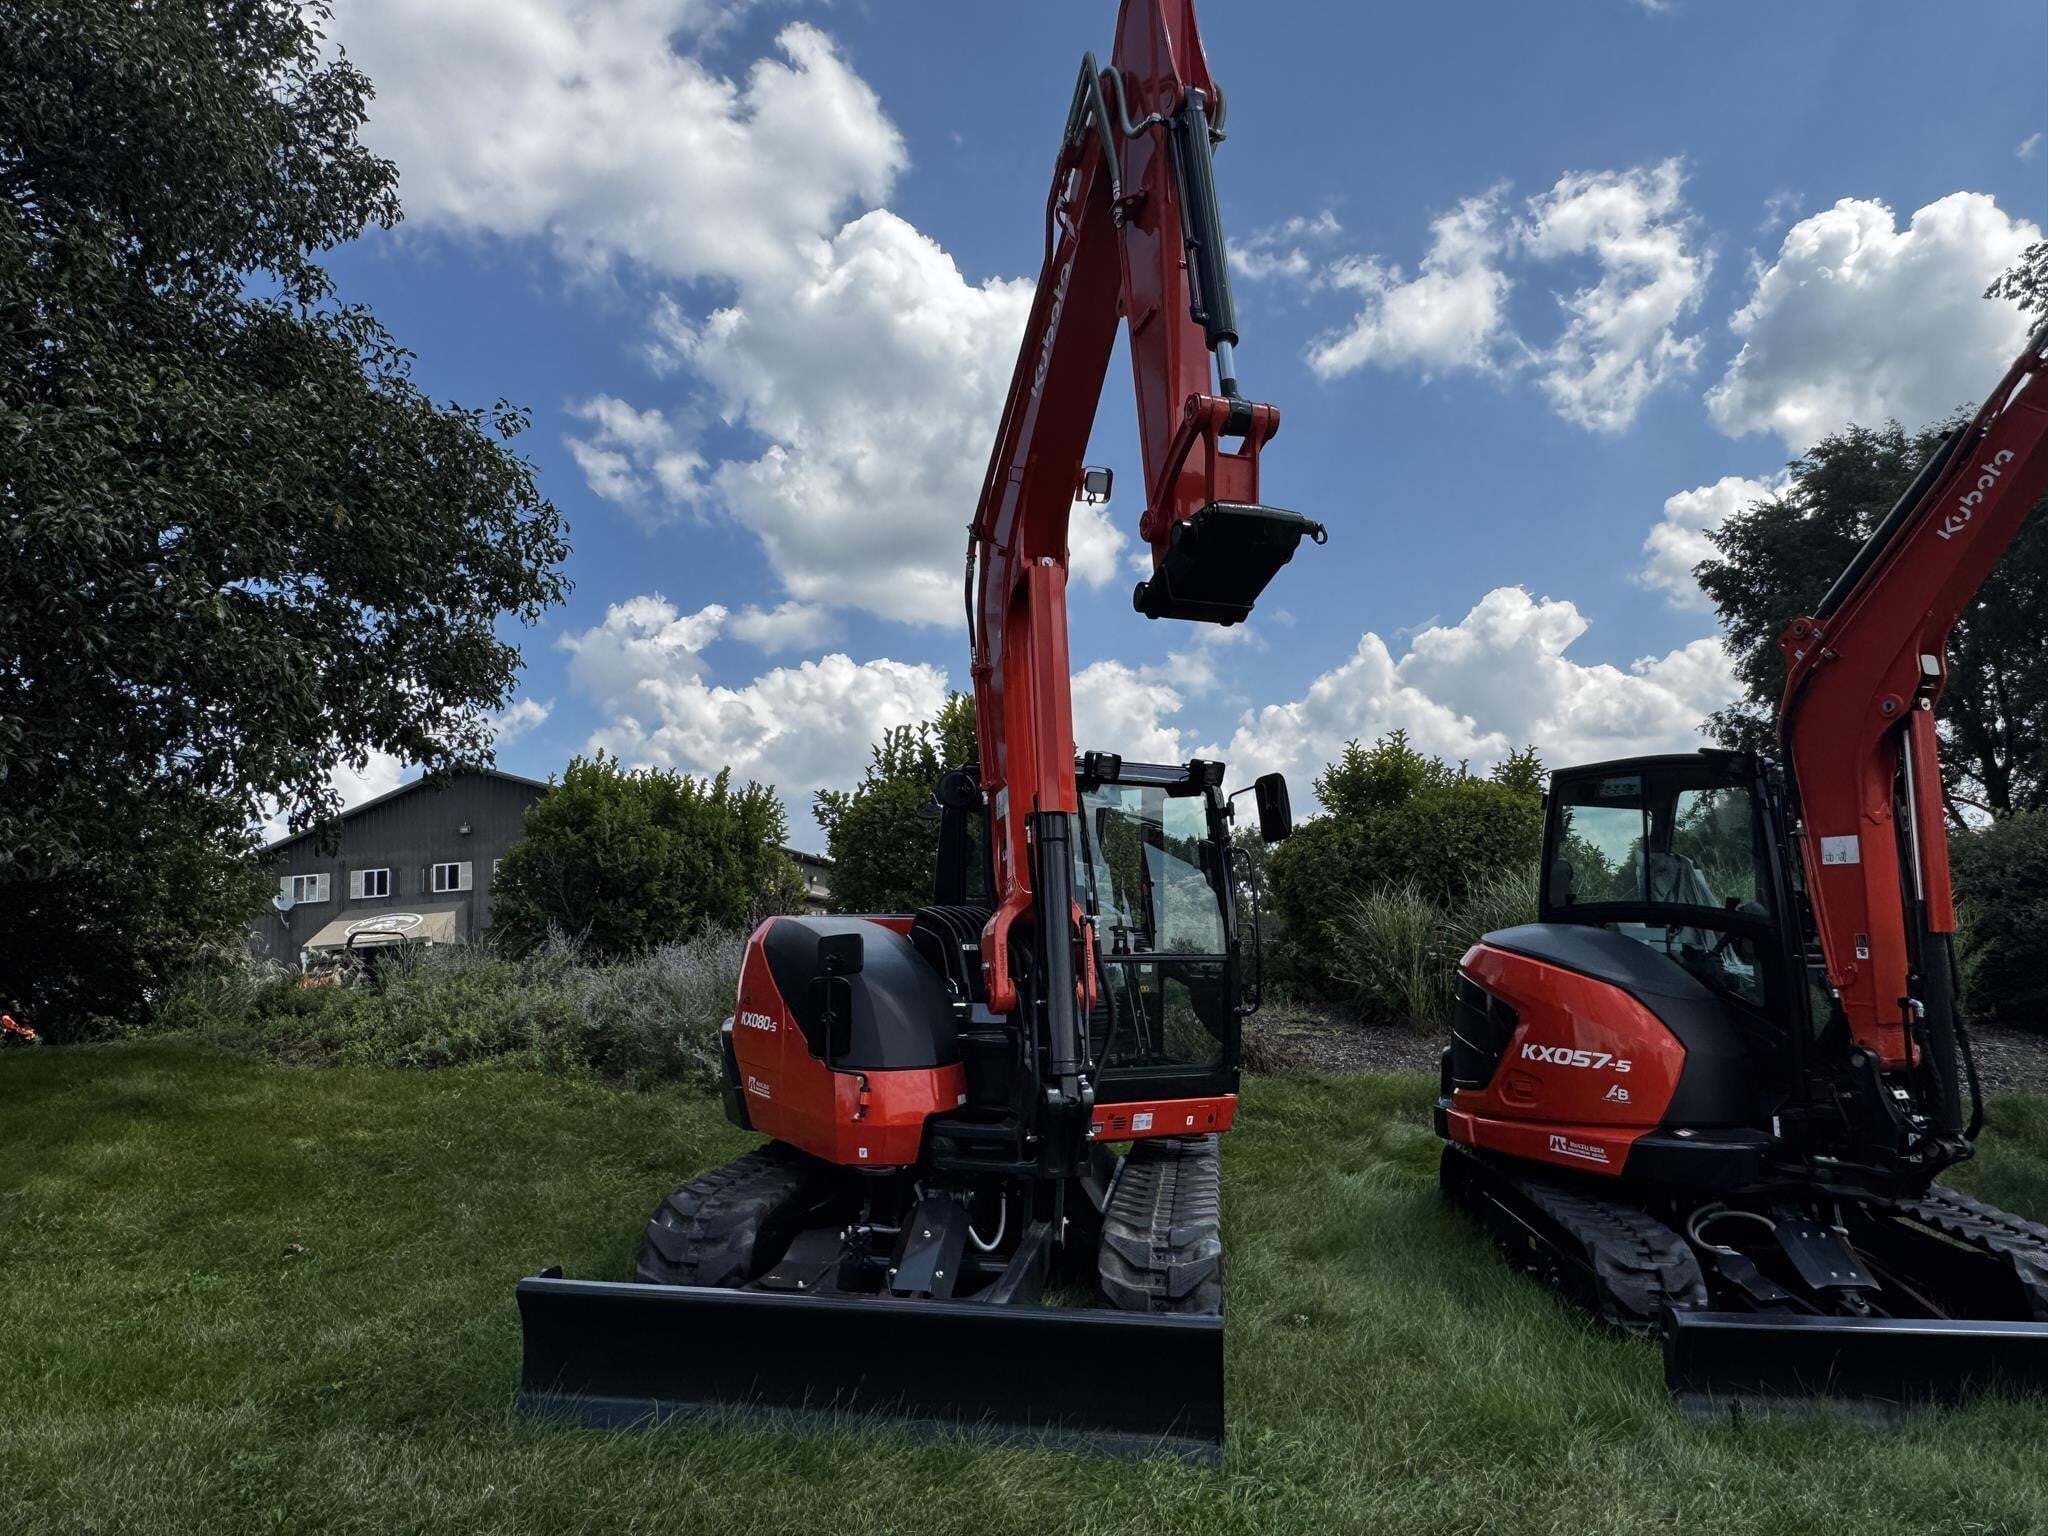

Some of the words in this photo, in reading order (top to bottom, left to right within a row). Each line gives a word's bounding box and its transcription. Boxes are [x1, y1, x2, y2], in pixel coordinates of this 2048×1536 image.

[1030, 262, 1070, 398] Kubota
[1936, 449, 2015, 540] Kubota
[741, 1011, 778, 1032] KX080-5
[1521, 1043, 1632, 1073] KX057-5
